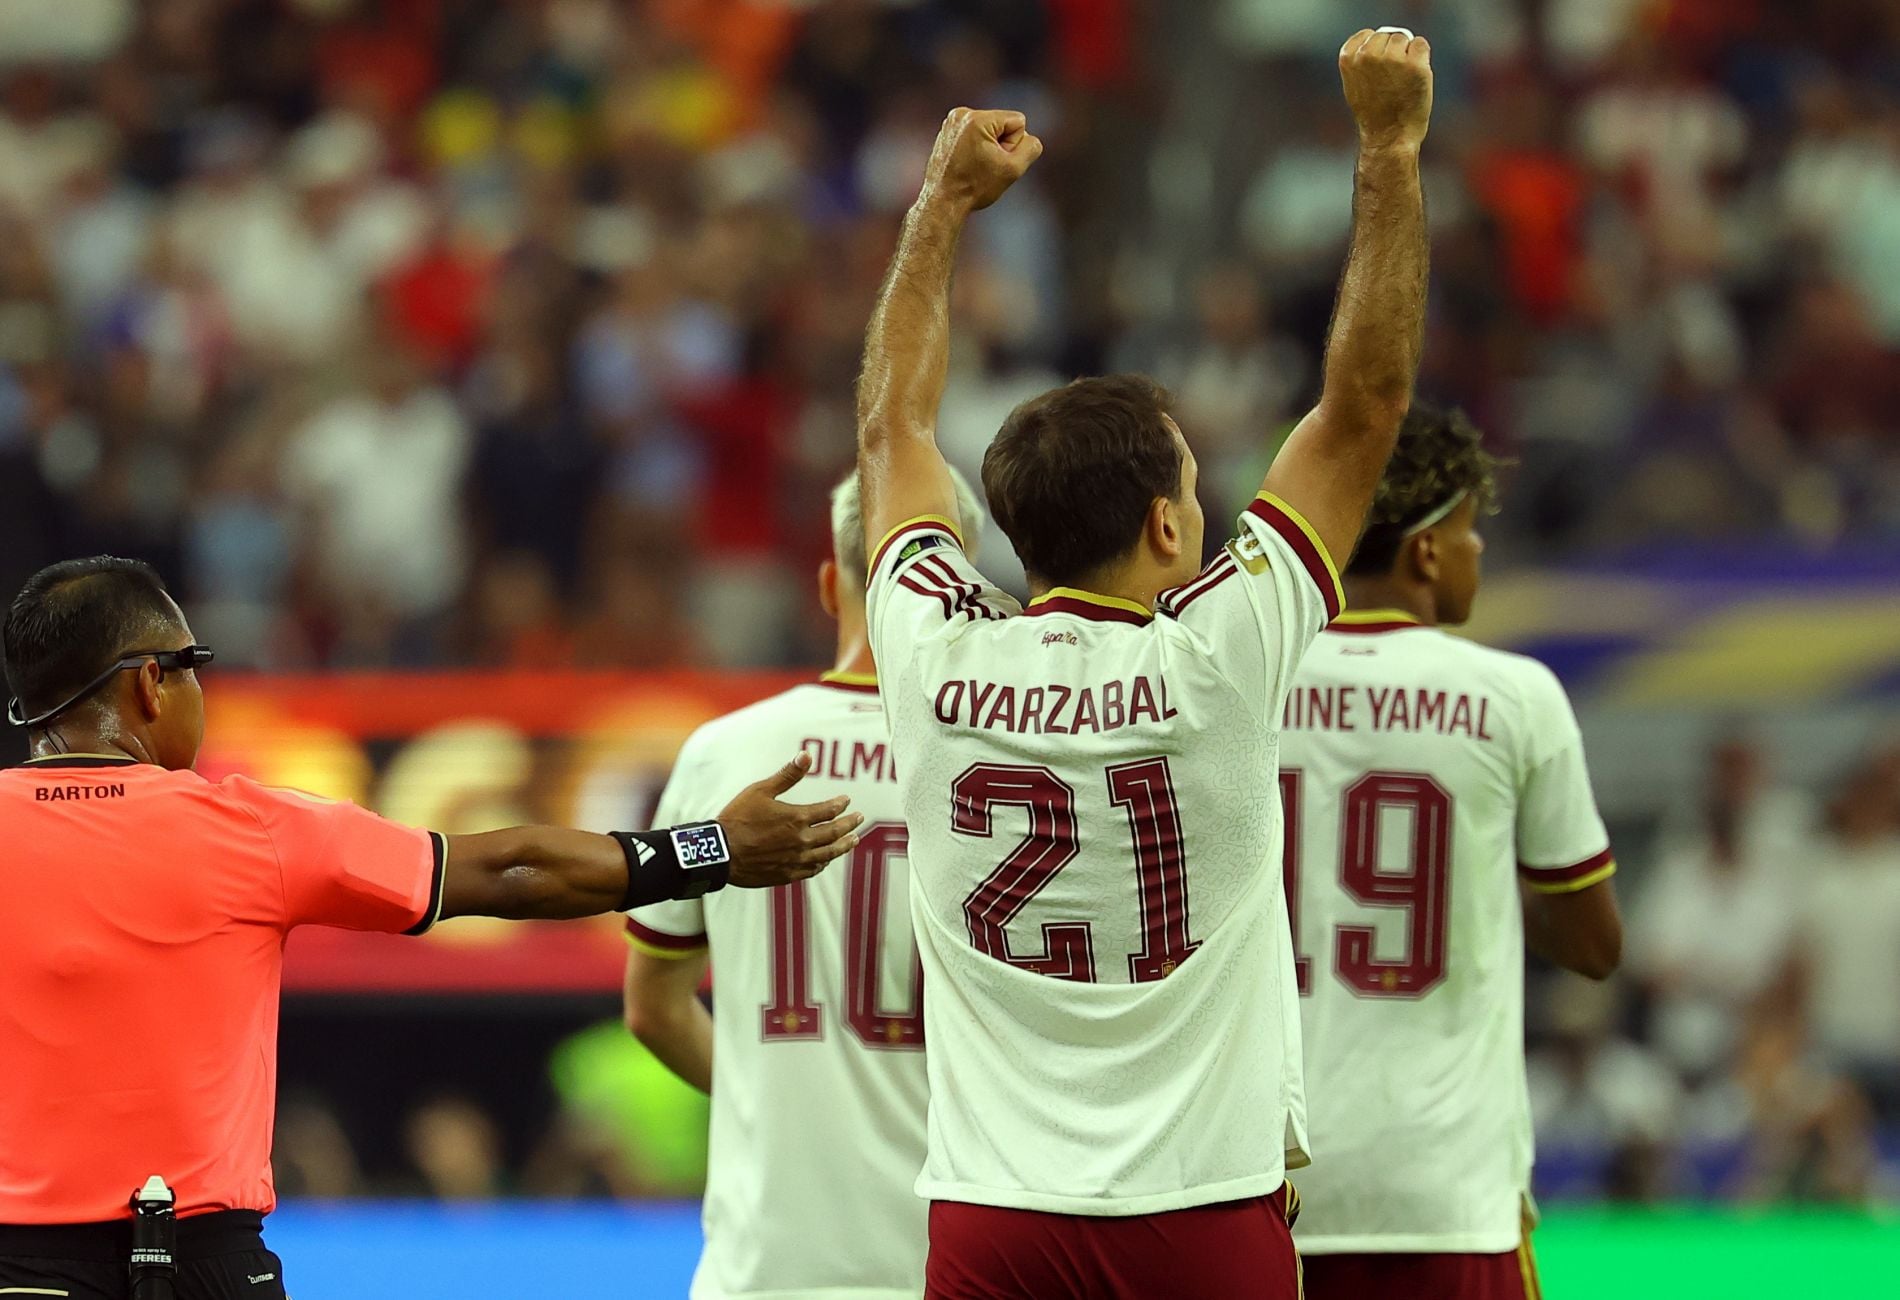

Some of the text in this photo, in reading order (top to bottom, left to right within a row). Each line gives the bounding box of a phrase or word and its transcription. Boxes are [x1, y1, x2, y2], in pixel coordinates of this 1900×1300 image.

[935, 674, 1178, 734] OYARZABAL
[1367, 687, 1492, 741] YAMAL
[801, 738, 897, 783] OLM
[35, 783, 125, 801] BARTON
[951, 755, 1203, 984] 21
